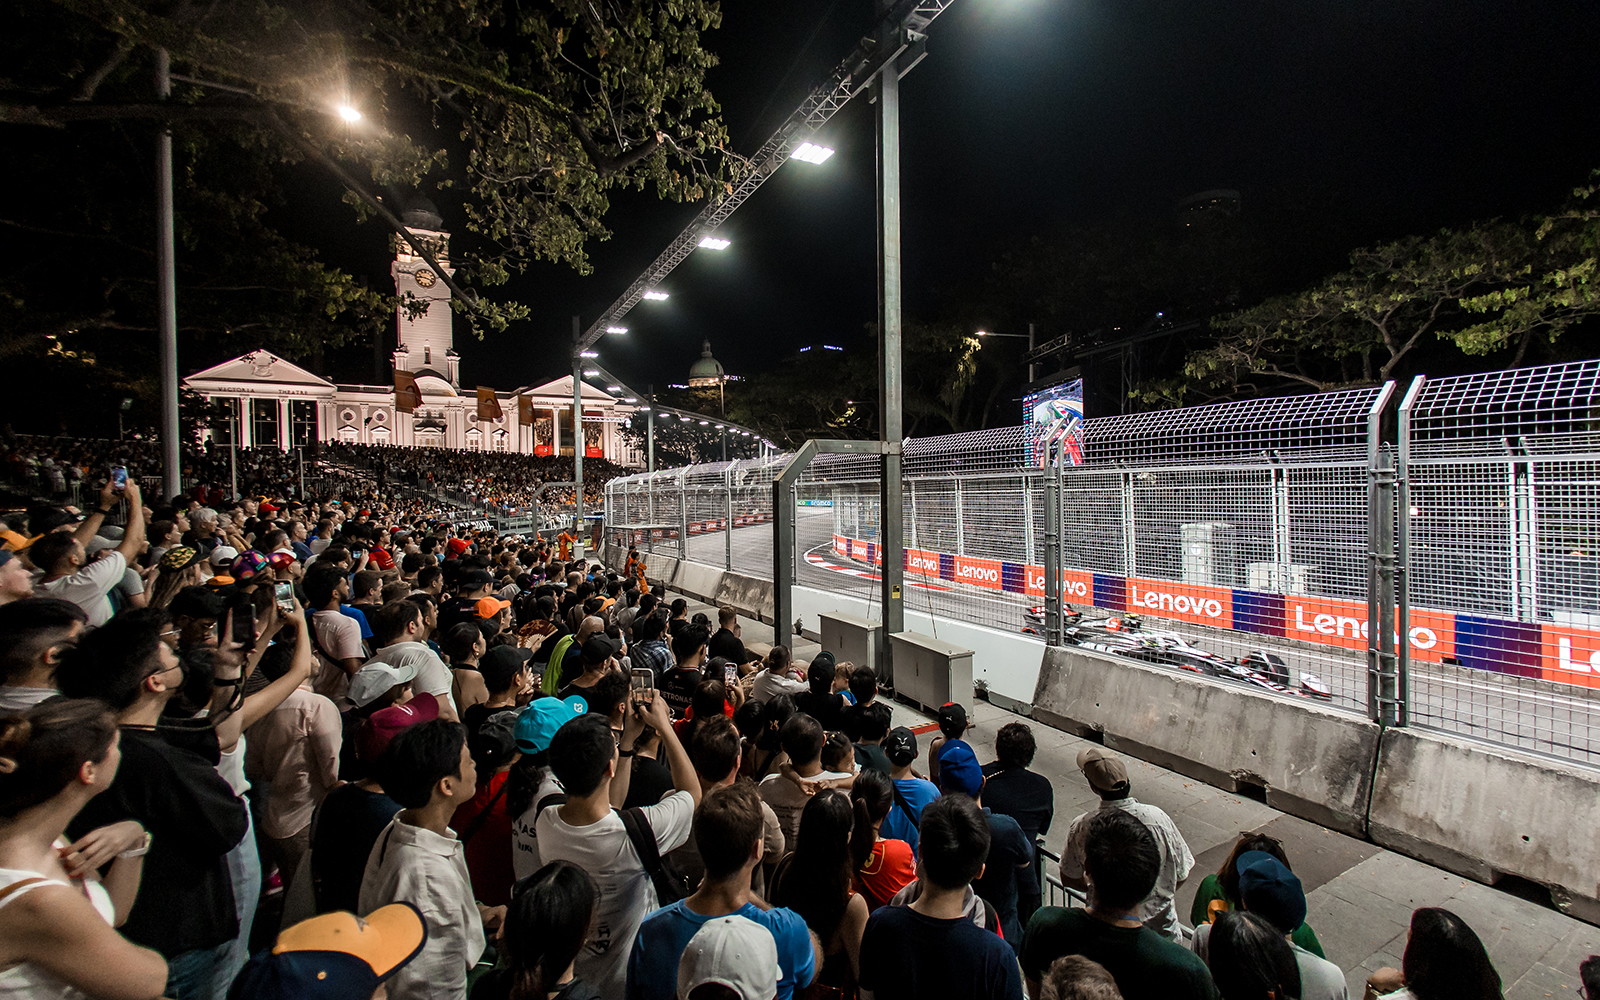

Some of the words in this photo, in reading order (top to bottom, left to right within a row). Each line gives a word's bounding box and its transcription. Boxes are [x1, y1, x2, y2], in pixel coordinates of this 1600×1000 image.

[908, 554, 937, 571] Lenovo
[956, 561, 998, 582] Lenovo
[1132, 585, 1222, 617] Lenovo
